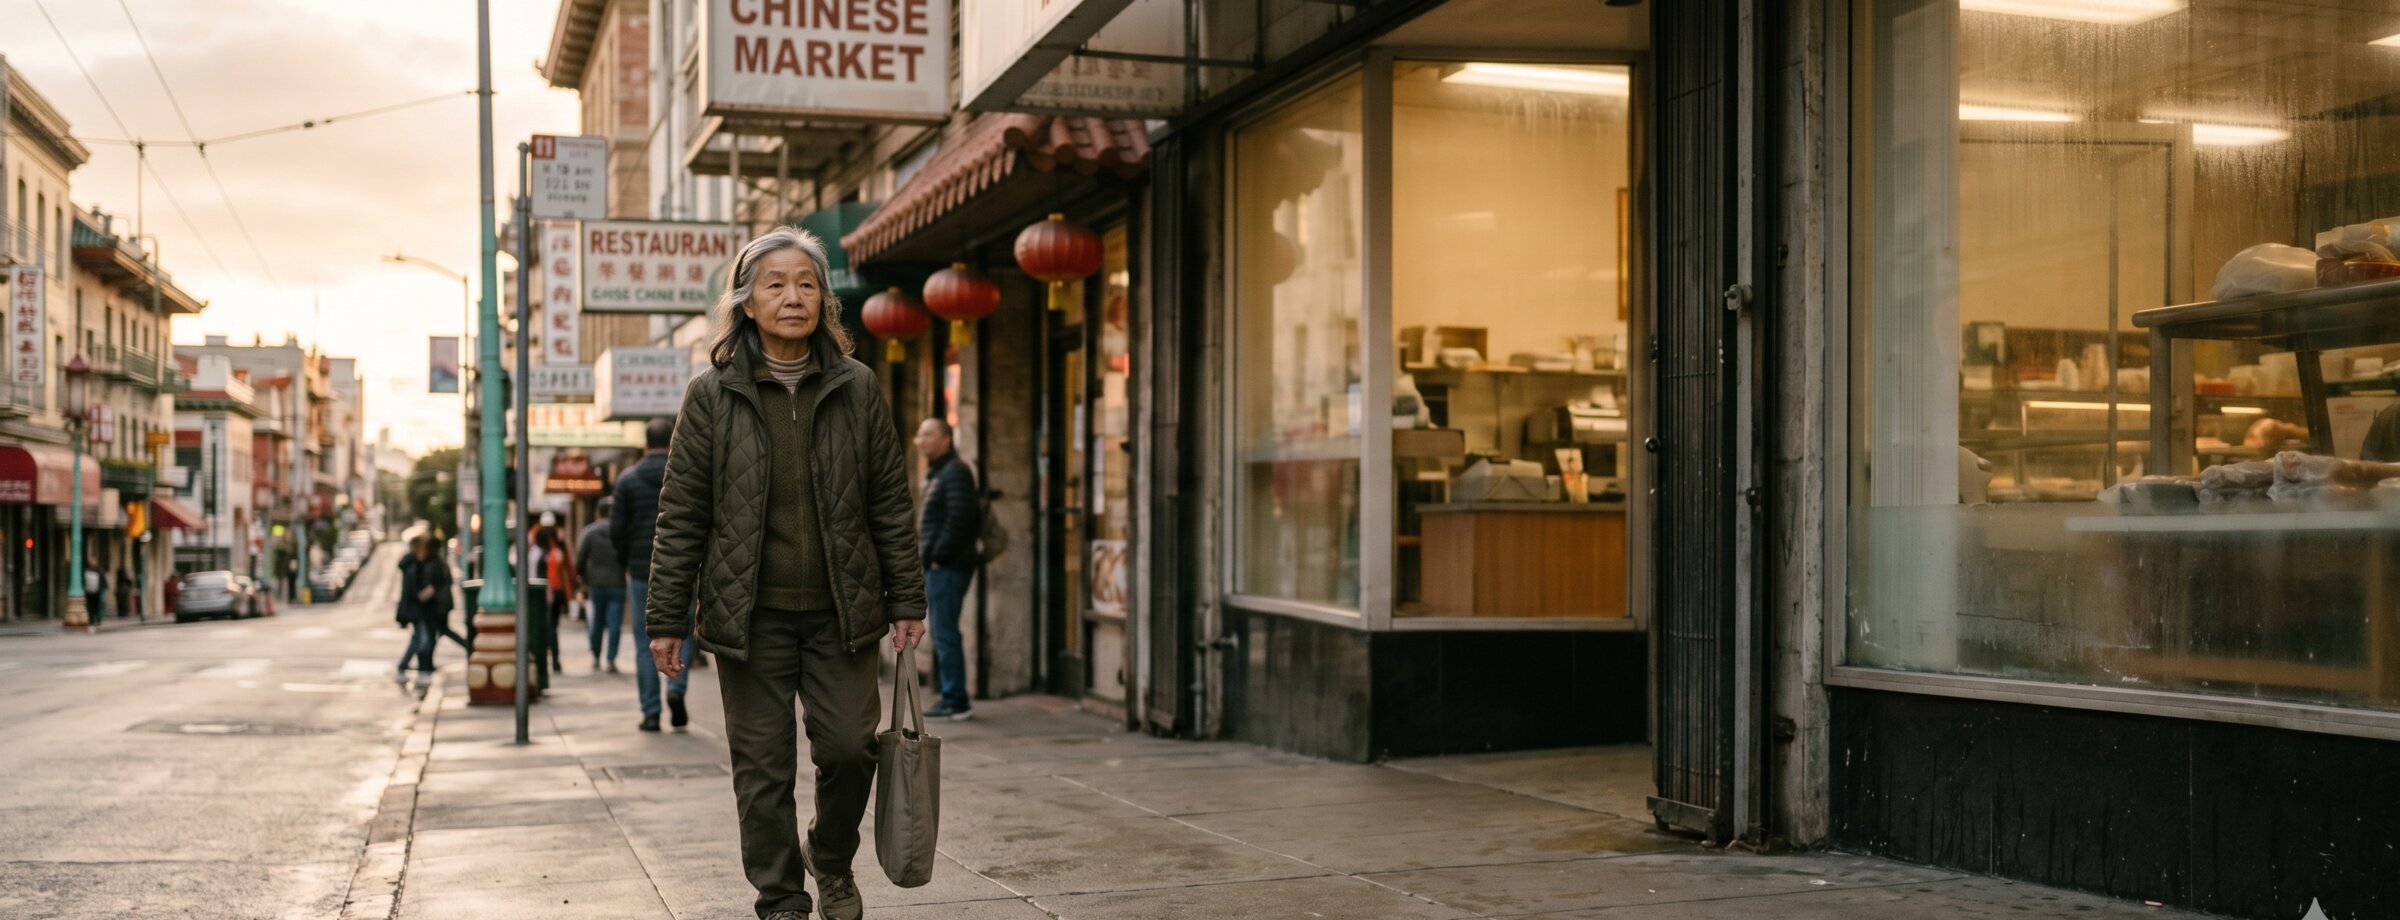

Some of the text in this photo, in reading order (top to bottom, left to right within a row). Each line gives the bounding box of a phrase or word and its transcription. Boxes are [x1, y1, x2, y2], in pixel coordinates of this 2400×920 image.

[730, 0, 928, 35] CHINESE
[735, 35, 924, 82] MARKET
[591, 229, 742, 258] RESTAURANT
